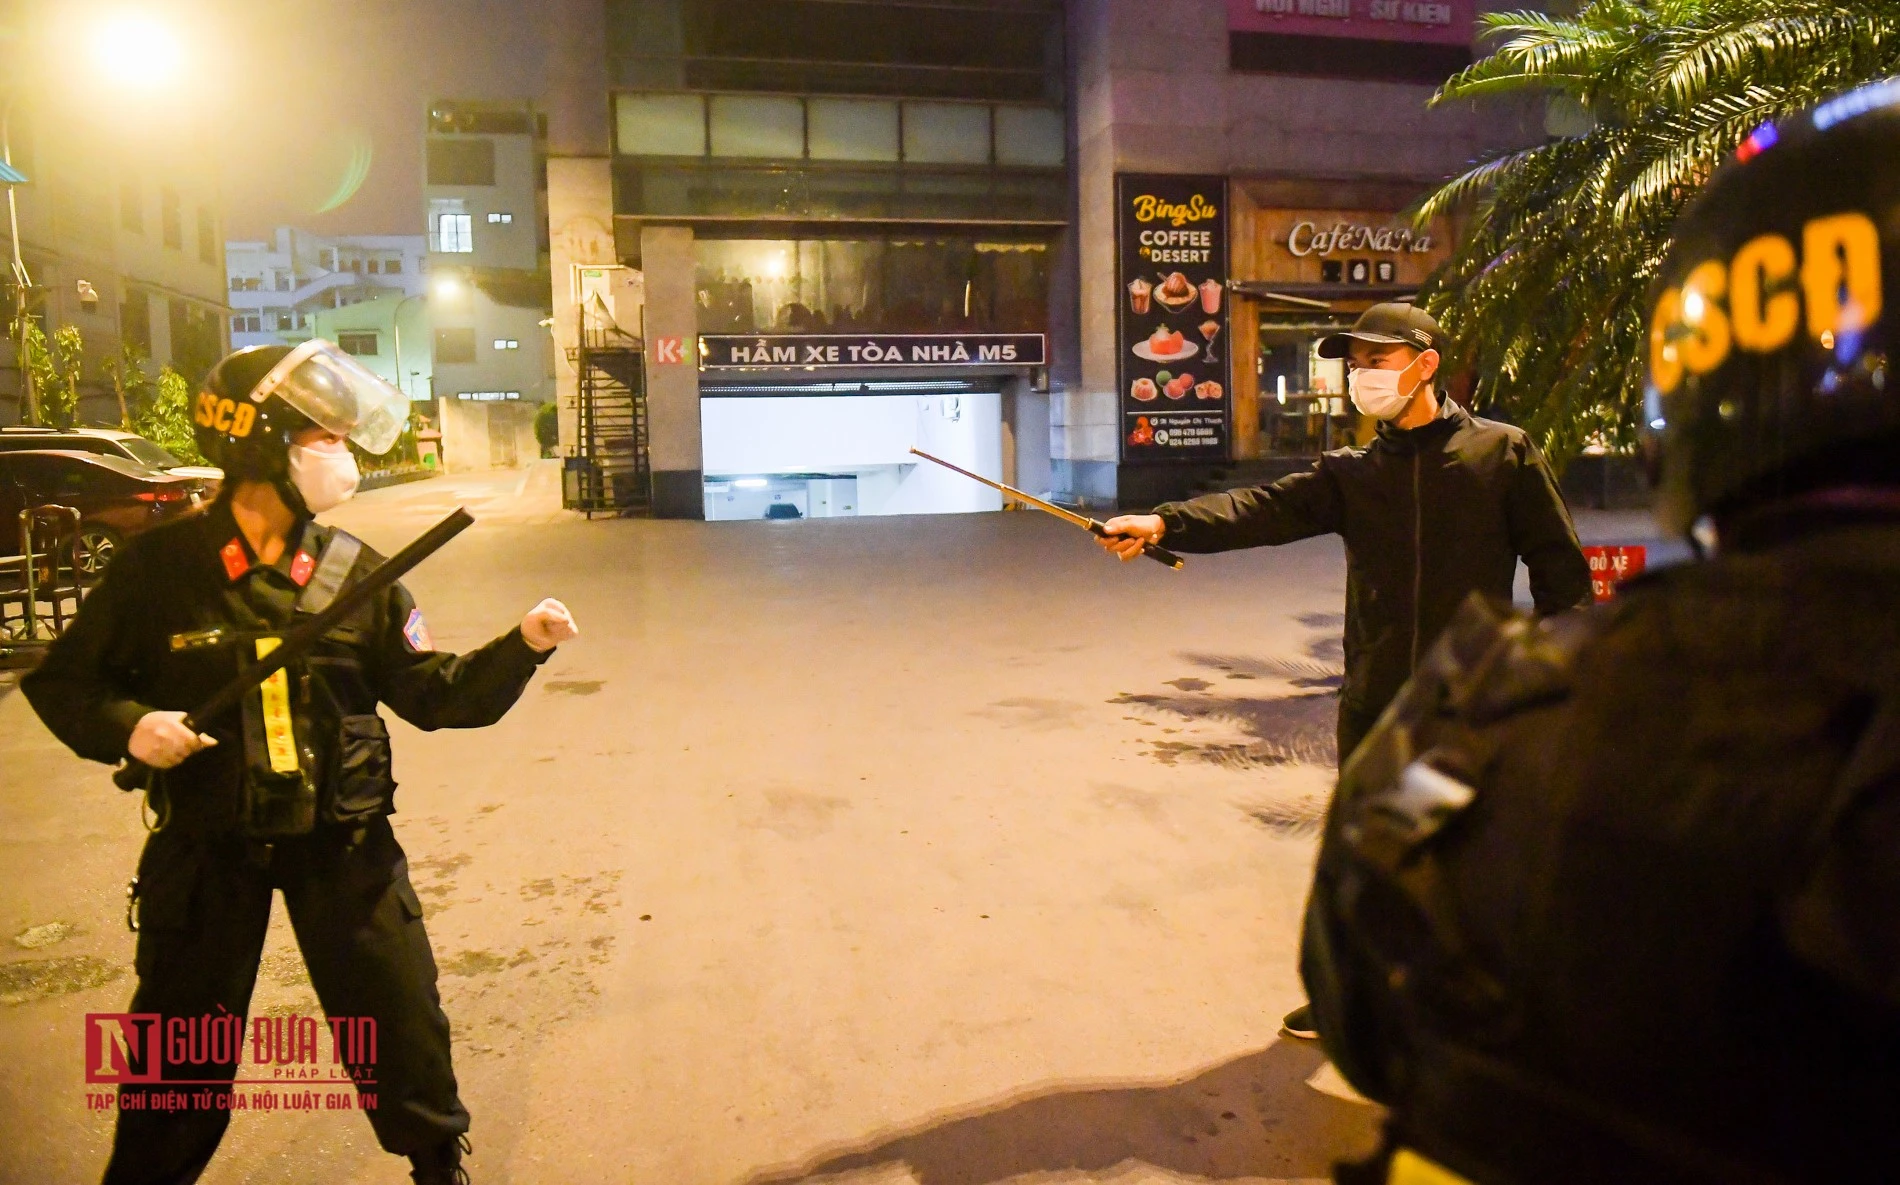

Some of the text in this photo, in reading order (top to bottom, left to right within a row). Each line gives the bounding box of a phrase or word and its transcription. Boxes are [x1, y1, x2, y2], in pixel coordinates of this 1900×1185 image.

[1133, 194, 1217, 227] BingSu
[1140, 230, 1211, 247] COFFEE
[1151, 249, 1210, 263] DESERT
[806, 346, 839, 362] XE
[848, 341, 903, 362] TÒA
[912, 341, 970, 361] NHÀ
[979, 345, 1017, 361] M5
